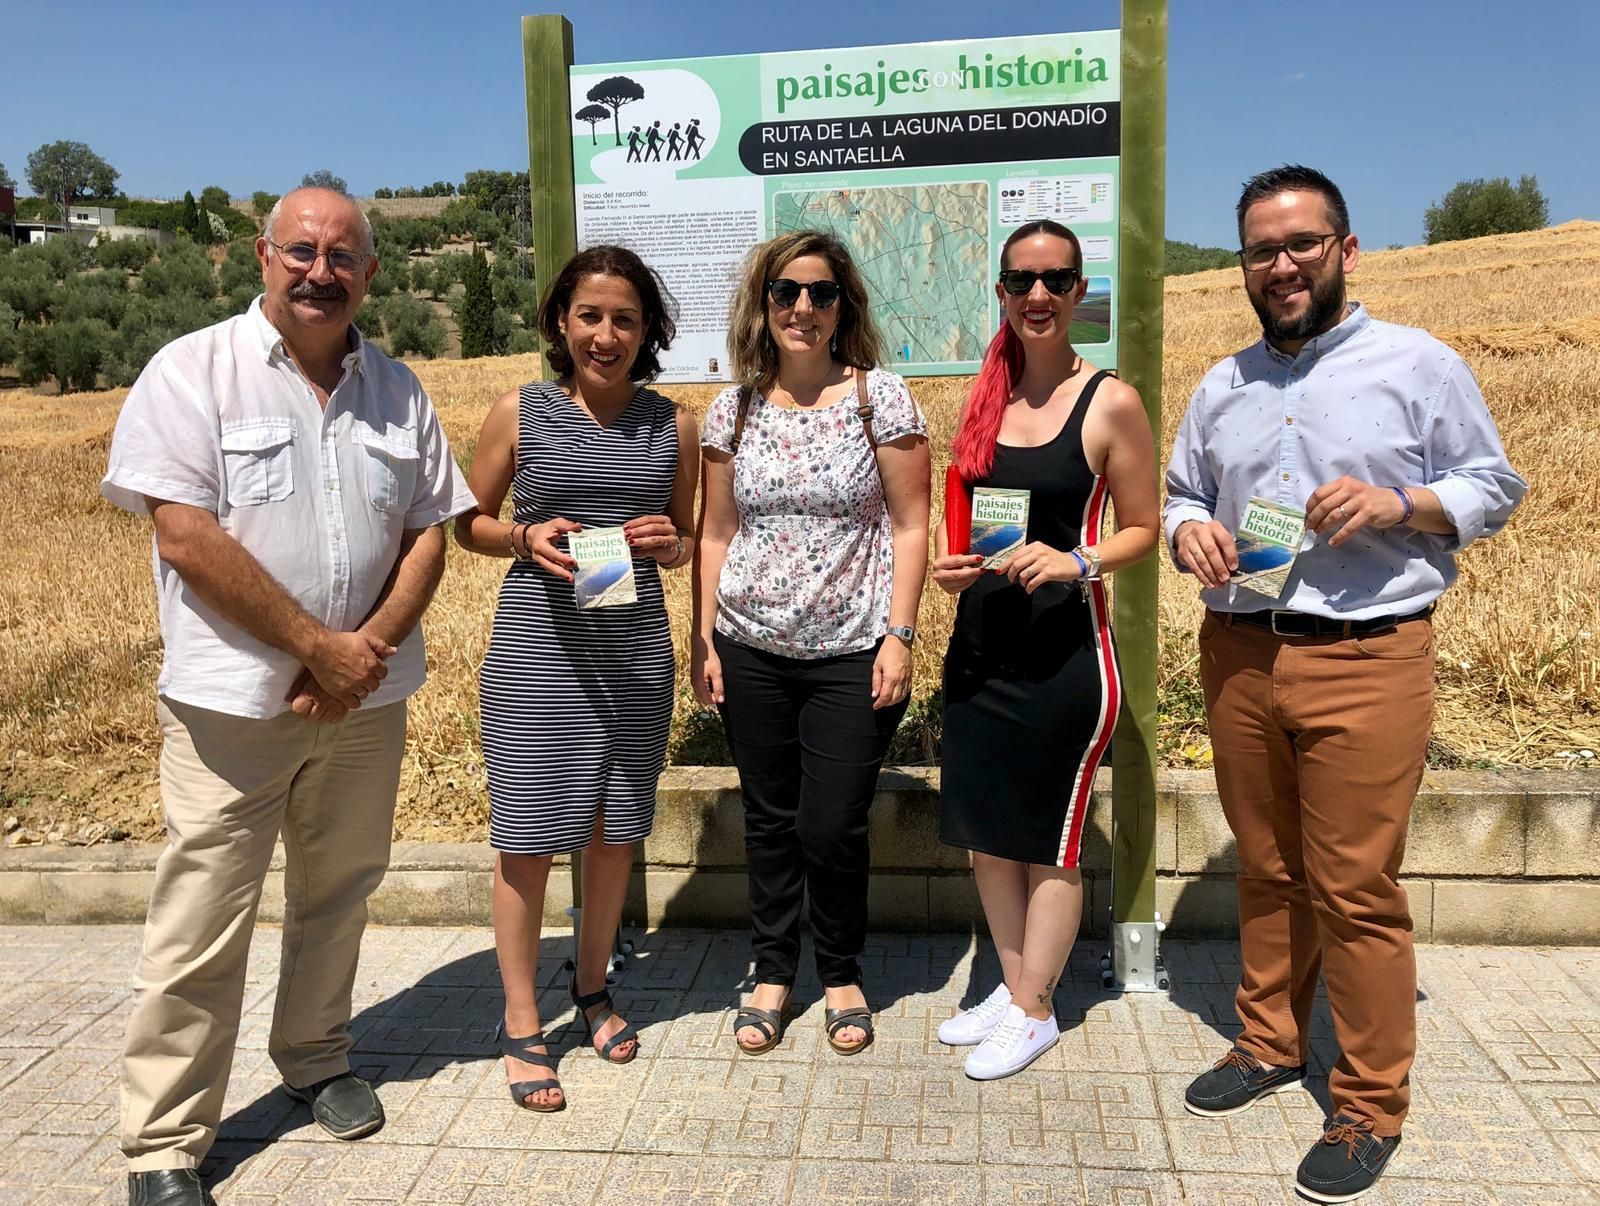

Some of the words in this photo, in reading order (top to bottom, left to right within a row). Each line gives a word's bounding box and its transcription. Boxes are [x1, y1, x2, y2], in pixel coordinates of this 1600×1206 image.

[777, 60, 927, 113] paisajes
[959, 48, 1108, 91] historia
[762, 125, 812, 144] RUTA
[818, 124, 843, 142] DE
[847, 122, 873, 139] LA
[883, 117, 964, 137] LAGUNA
[969, 114, 1008, 132] DEL
[1012, 106, 1107, 130] DONADÍO
[763, 151, 790, 169] EN
[794, 146, 905, 167] SANTAELLA
[616, 190, 648, 198] recorrido:
[975, 497, 1023, 510] paisajes
[976, 508, 1019, 521] historia
[1249, 510, 1301, 533] paisajes
[1245, 517, 1293, 543] historia
[574, 537, 623, 550] paisajes
[576, 547, 622, 560] historia
